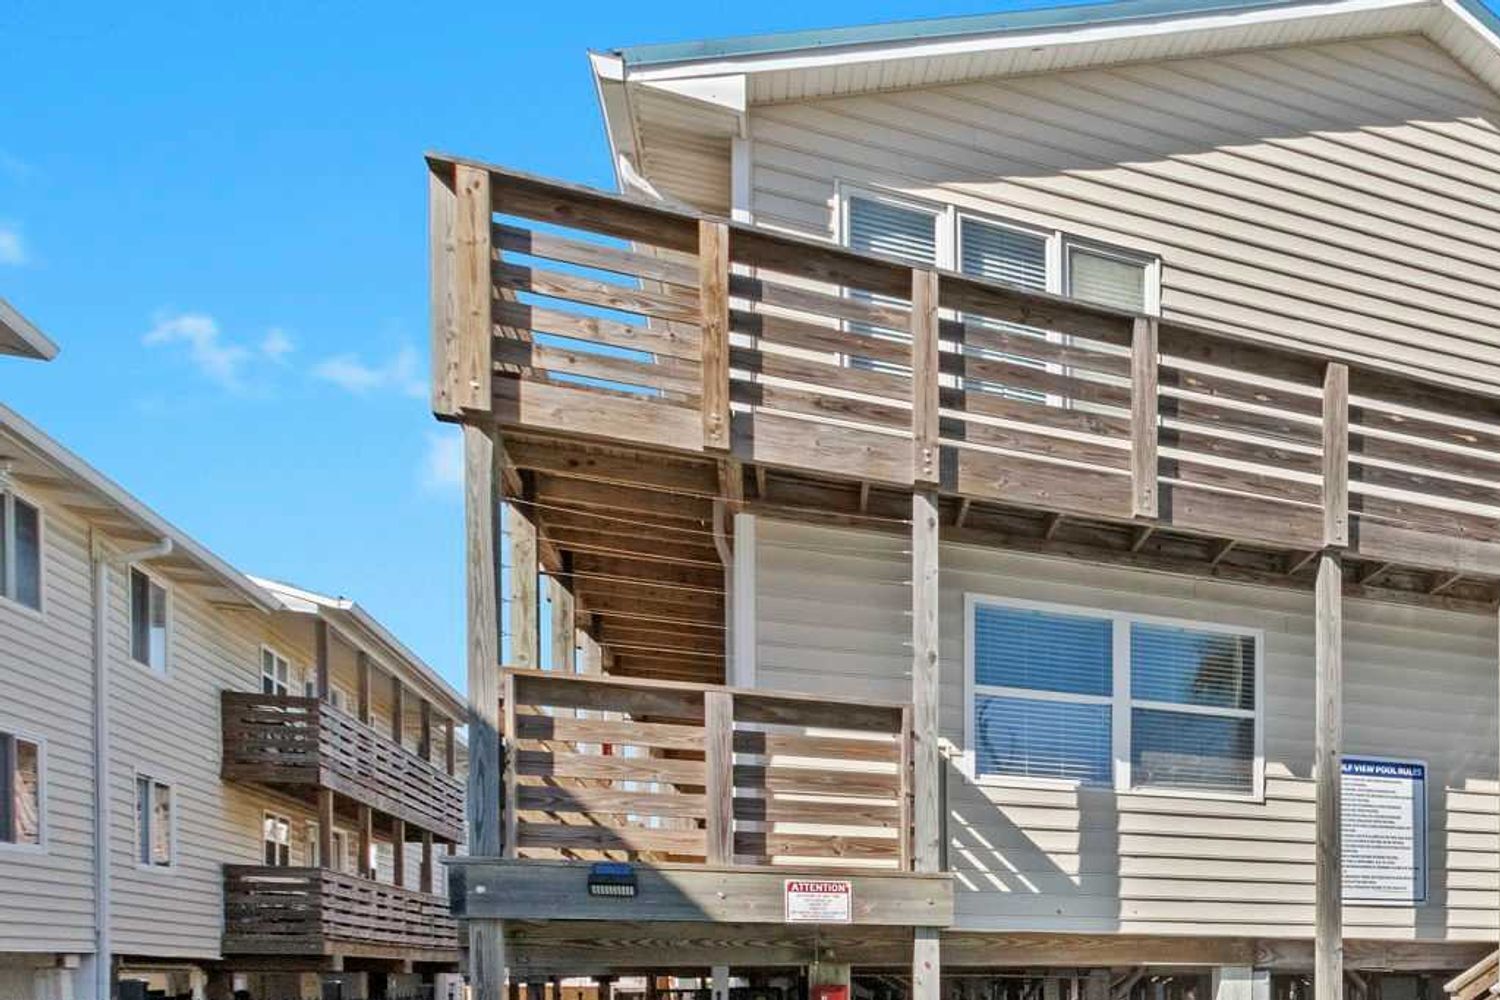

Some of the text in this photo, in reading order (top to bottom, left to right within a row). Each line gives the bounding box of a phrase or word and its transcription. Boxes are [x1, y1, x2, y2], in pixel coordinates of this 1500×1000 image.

[1353, 763, 1375, 773] VIEW
[1375, 765, 1397, 774] POOL
[1397, 766, 1422, 776] RULES
[791, 882, 846, 892] ATTENTION
